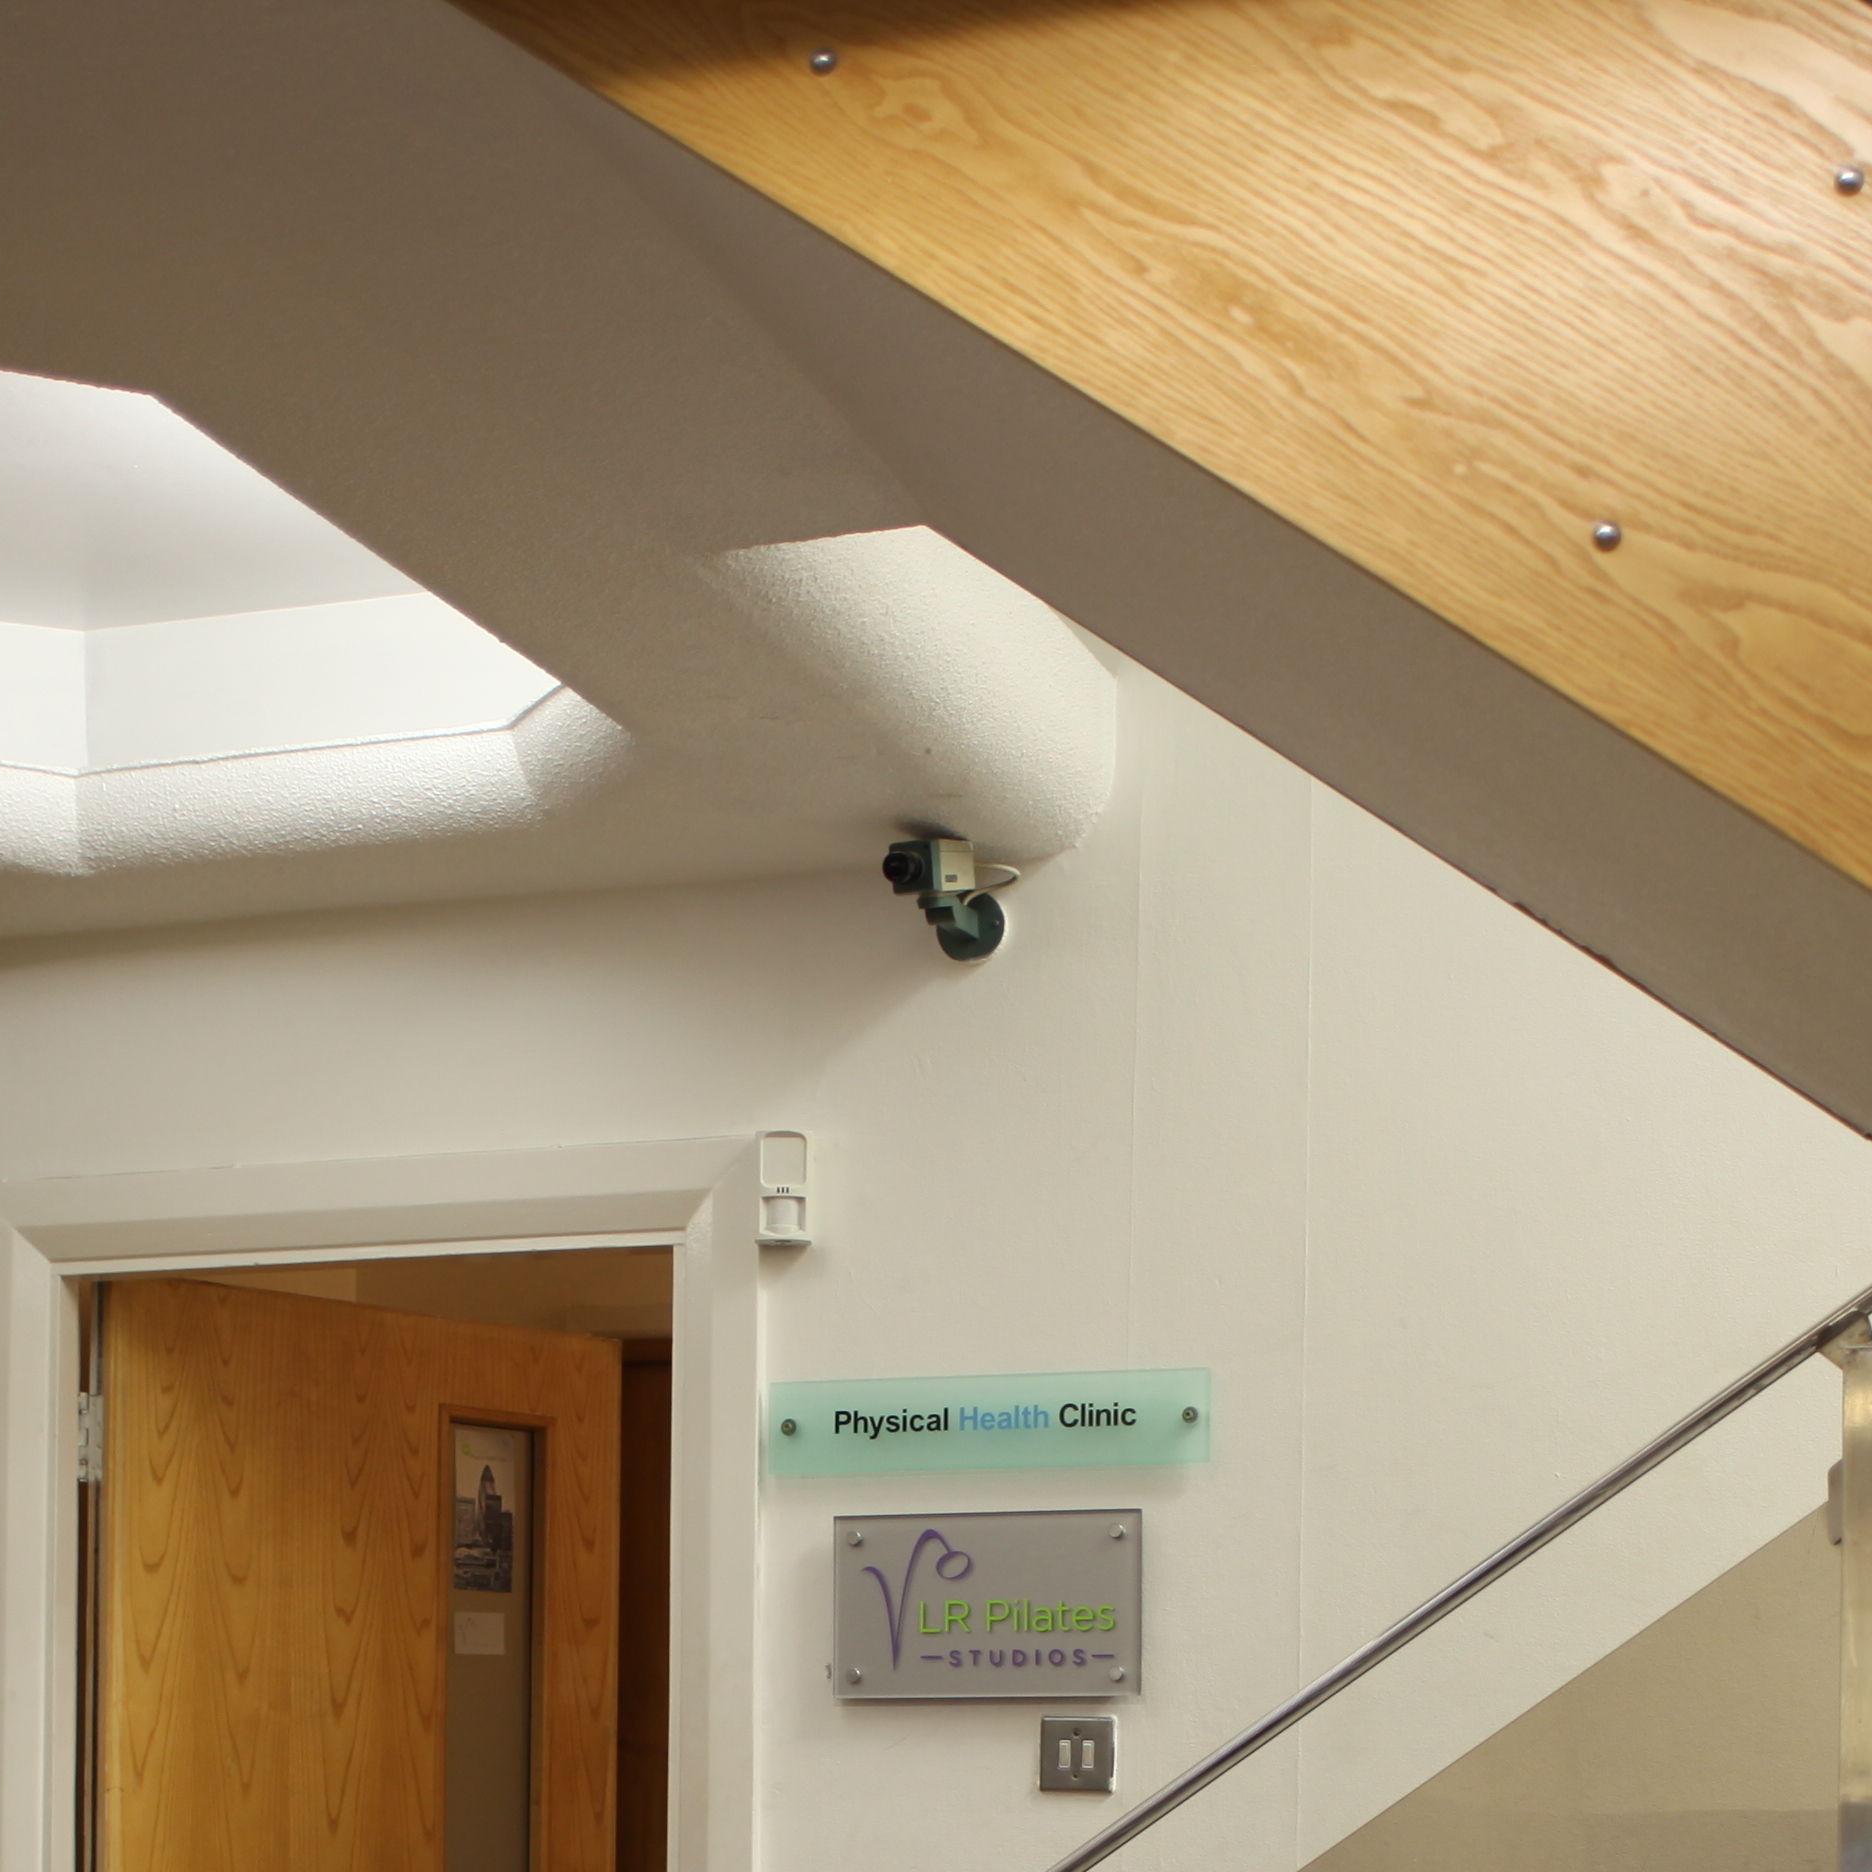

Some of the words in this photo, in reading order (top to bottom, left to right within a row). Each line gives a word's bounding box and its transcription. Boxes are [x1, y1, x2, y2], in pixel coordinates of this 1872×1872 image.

[834, 1407, 949, 1440] Physical
[959, 1404, 1051, 1432] Health
[1059, 1402, 1137, 1428] Clinic
[918, 1600, 972, 1634] LR
[986, 1598, 1116, 1634] Pilates
[949, 1648, 1086, 1667] STUDIOS
